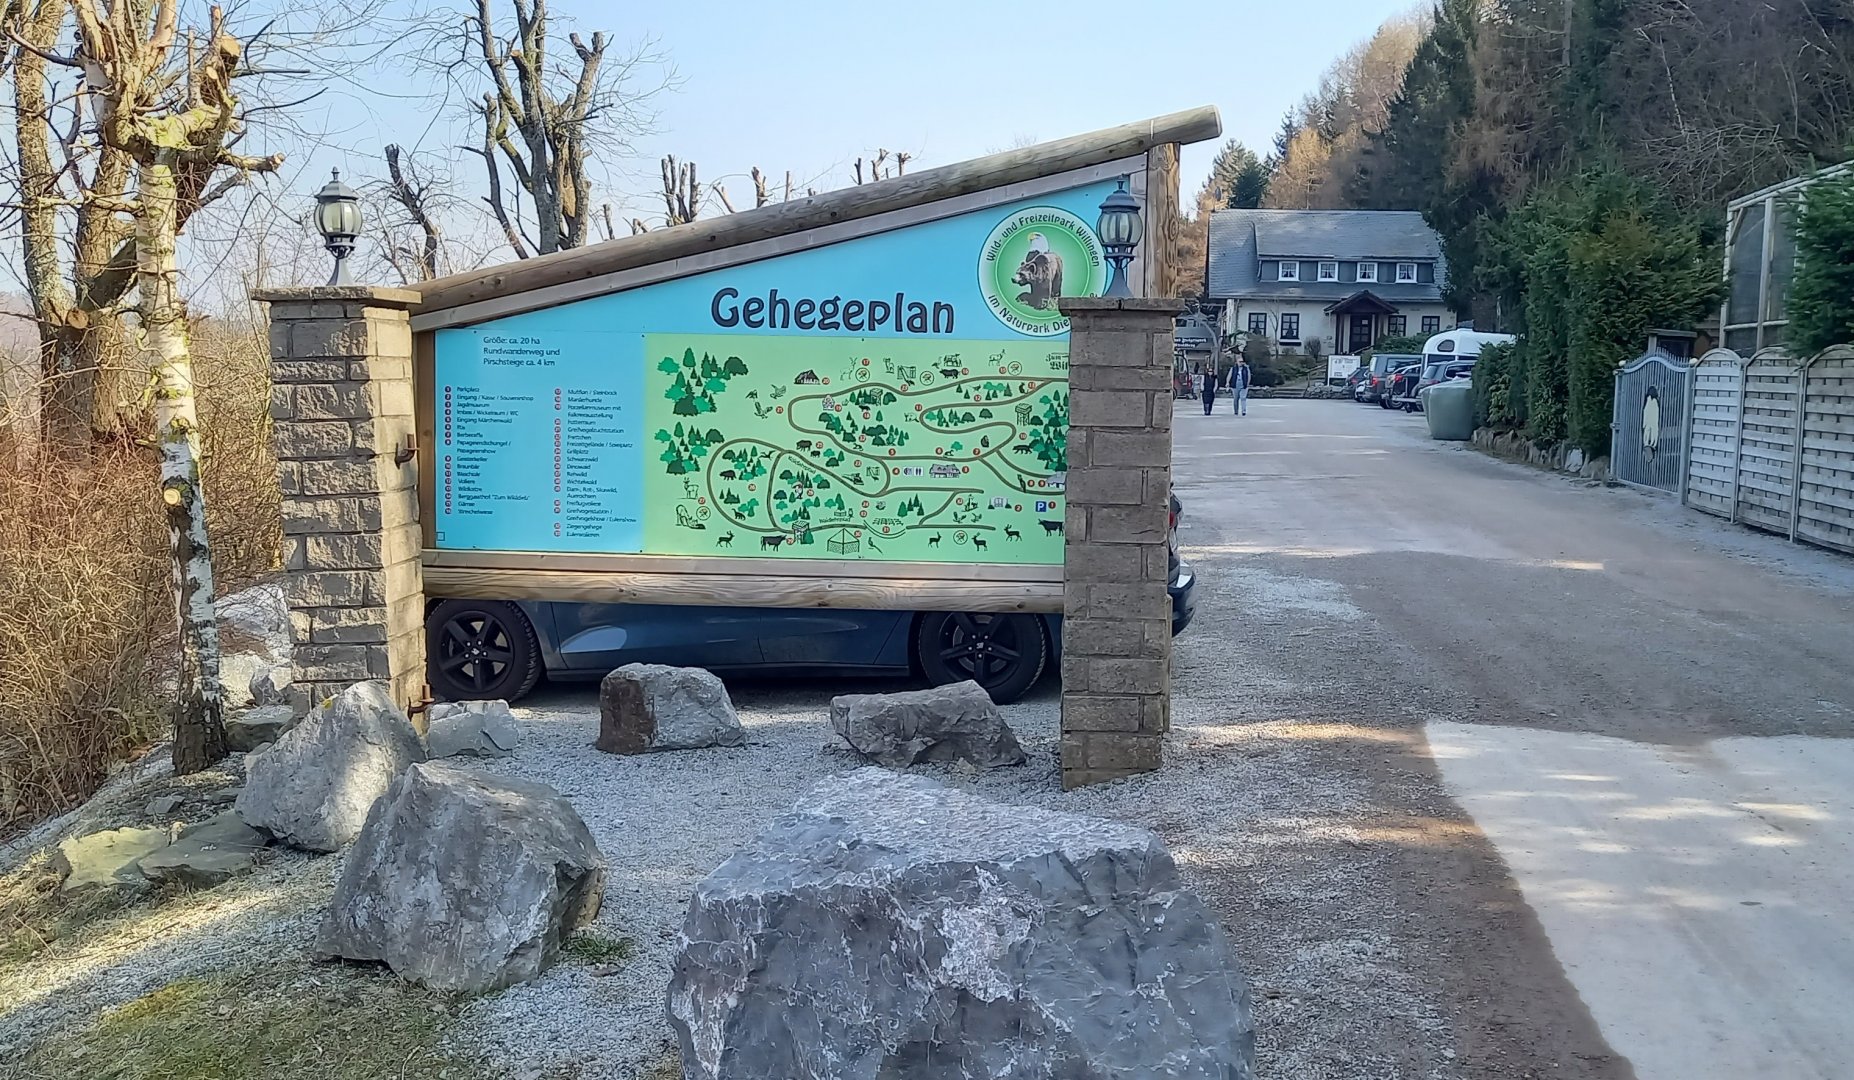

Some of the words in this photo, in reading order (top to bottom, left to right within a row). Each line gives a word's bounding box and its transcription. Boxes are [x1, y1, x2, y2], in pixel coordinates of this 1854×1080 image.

[986, 238, 1002, 261] Wild-
[1002, 222, 1018, 237] und
[1018, 214, 1075, 230] Freizeitpark
[1076, 226, 1099, 266] Willingen
[711, 287, 954, 334] Gehegeplan
[999, 308, 1050, 332] Naturpark
[1053, 318, 1071, 331] Die
[483, 348, 544, 357] Rundwanderweg
[483, 358, 524, 367] Pirschsteige
